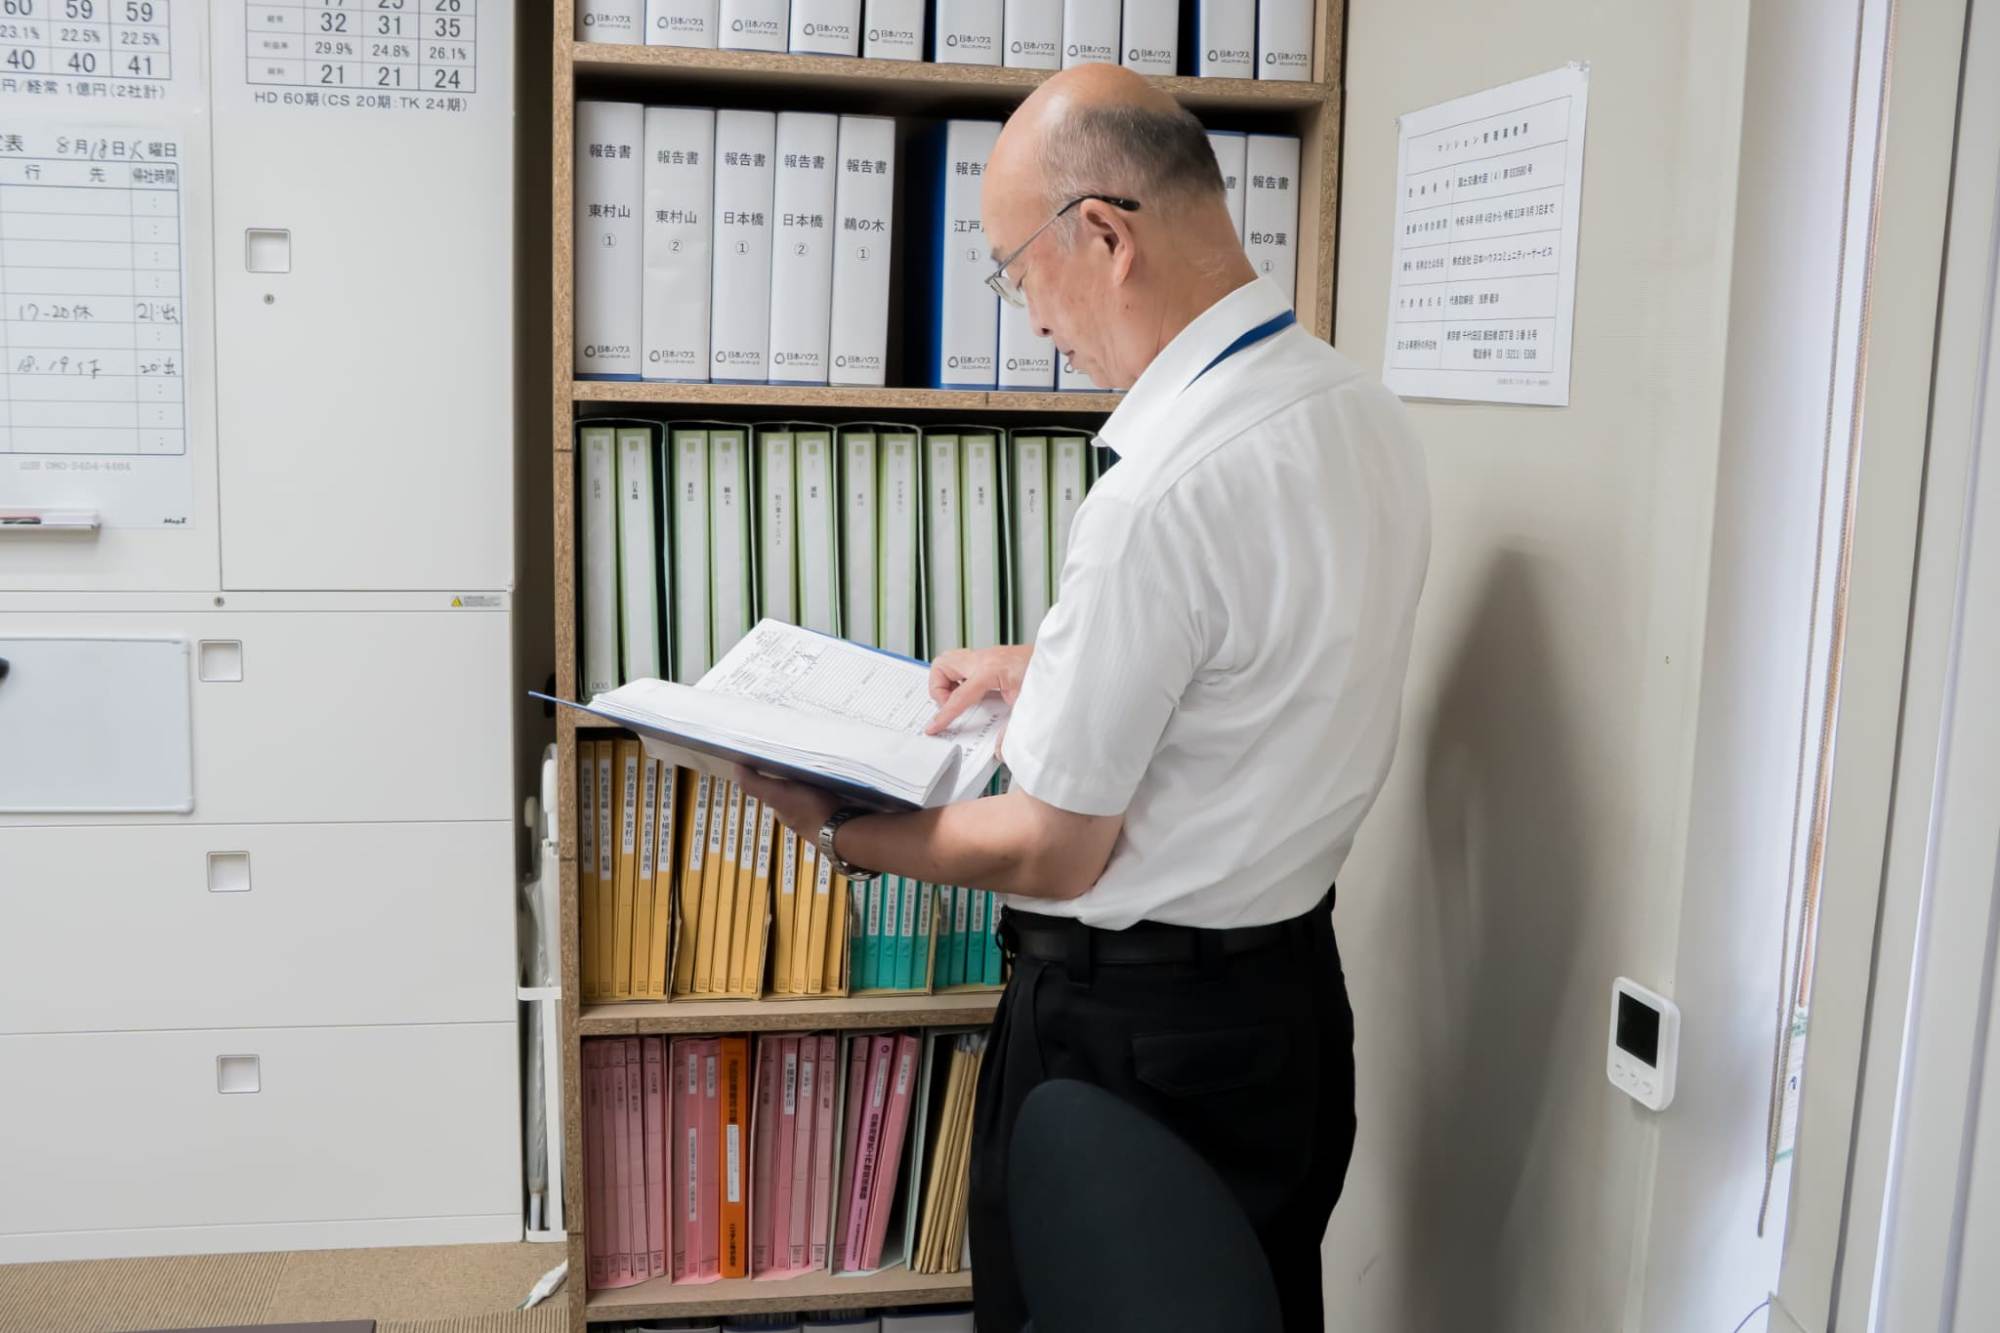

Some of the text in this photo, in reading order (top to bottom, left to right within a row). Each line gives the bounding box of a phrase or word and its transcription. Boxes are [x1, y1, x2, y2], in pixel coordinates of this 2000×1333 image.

[66, 0, 93, 19] 59
[126, 2, 153, 22] 59
[320, 12, 347, 32] 32
[378, 15, 401, 35] 31
[435, 18, 461, 38] 35
[61, 28, 101, 43] 22.5%
[121, 31, 160, 46] 22.5%
[315, 41, 353, 56] 29.9%
[372, 44, 411, 58] 24.8%
[430, 46, 467, 61] 26.1%
[7, 49, 152, 76] 40 40 41
[321, 64, 461, 89] 21 21 24
[254, 92, 278, 104] HD
[589, 144, 631, 159] 報告書
[657, 150, 699, 165] 報告書
[724, 152, 766, 167] 報告書
[784, 154, 825, 170] 報告書
[847, 159, 887, 175] 報告書
[955, 162, 988, 176] 報告
[1253, 175, 1289, 190] 報告書
[588, 204, 631, 218] 東村山
[655, 209, 697, 224] 東村山
[723, 211, 764, 226] 日本橋
[783, 214, 824, 229] 日本橋
[954, 219, 984, 233] 江戸
[1250, 231, 1287, 246] 柏の葉
